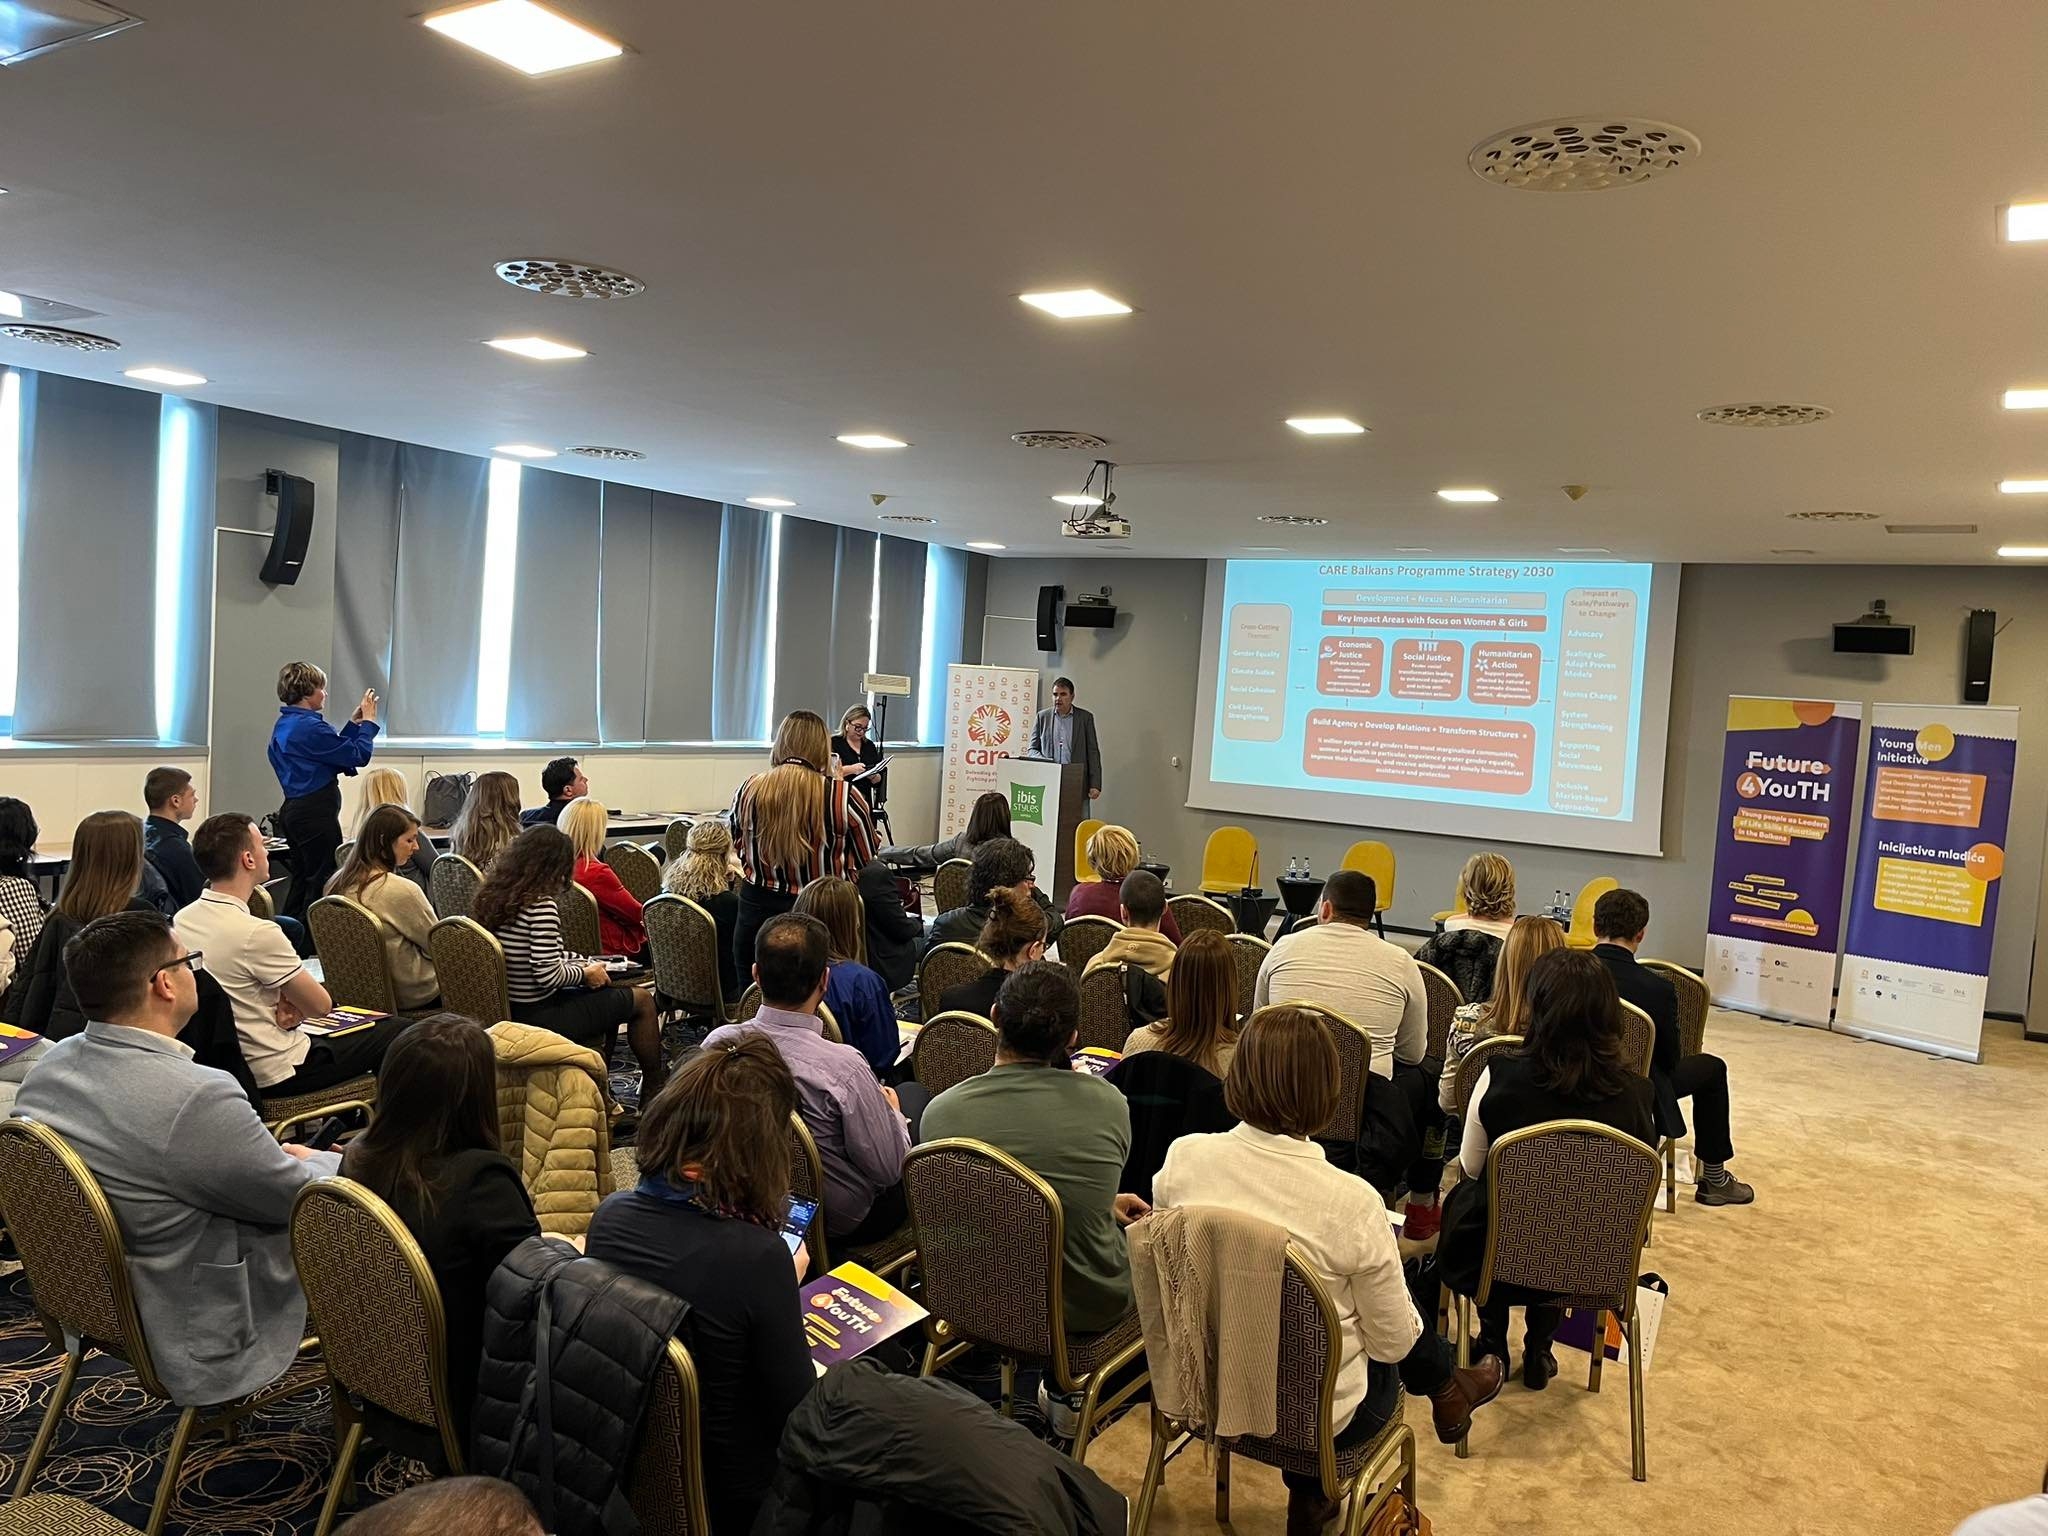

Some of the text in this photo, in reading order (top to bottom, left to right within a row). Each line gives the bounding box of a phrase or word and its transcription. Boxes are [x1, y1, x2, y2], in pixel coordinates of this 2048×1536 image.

[1319, 565, 1554, 579] CARE Balkans Programme Strategy 2030
[1355, 593, 1508, 606] Development Nexus Humanitarian
[1337, 614, 1528, 627] Key Impact Areas with focus on Women & Girls
[1567, 629, 1604, 639] Advocacy
[1338, 640, 1373, 649] Economic
[1255, 650, 1281, 659] Equality
[1339, 651, 1363, 659] Justice
[1403, 652, 1452, 662] Social Justice
[1478, 649, 1533, 660] Humanitarian
[1491, 661, 1518, 669] Action
[1312, 718, 1520, 739] Build Agency Develop Relations Transform Structures
[1879, 738, 1942, 752] Young Men
[1748, 750, 1825, 775] Future
[1877, 751, 1929, 765] Initiative
[1740, 776, 1831, 802] 4YouTH
[1017, 790, 1037, 805] ibis
[1741, 809, 1763, 819] Young
[1763, 813, 1787, 823] people
[1798, 818, 1828, 829] Leaders
[1746, 829, 1758, 838] the
[1758, 831, 1788, 842] Balkans
[1783, 825, 1821, 837] Education
[1878, 840, 1986, 864] Inicijativa mladića
[831, 1286, 881, 1323] Future
